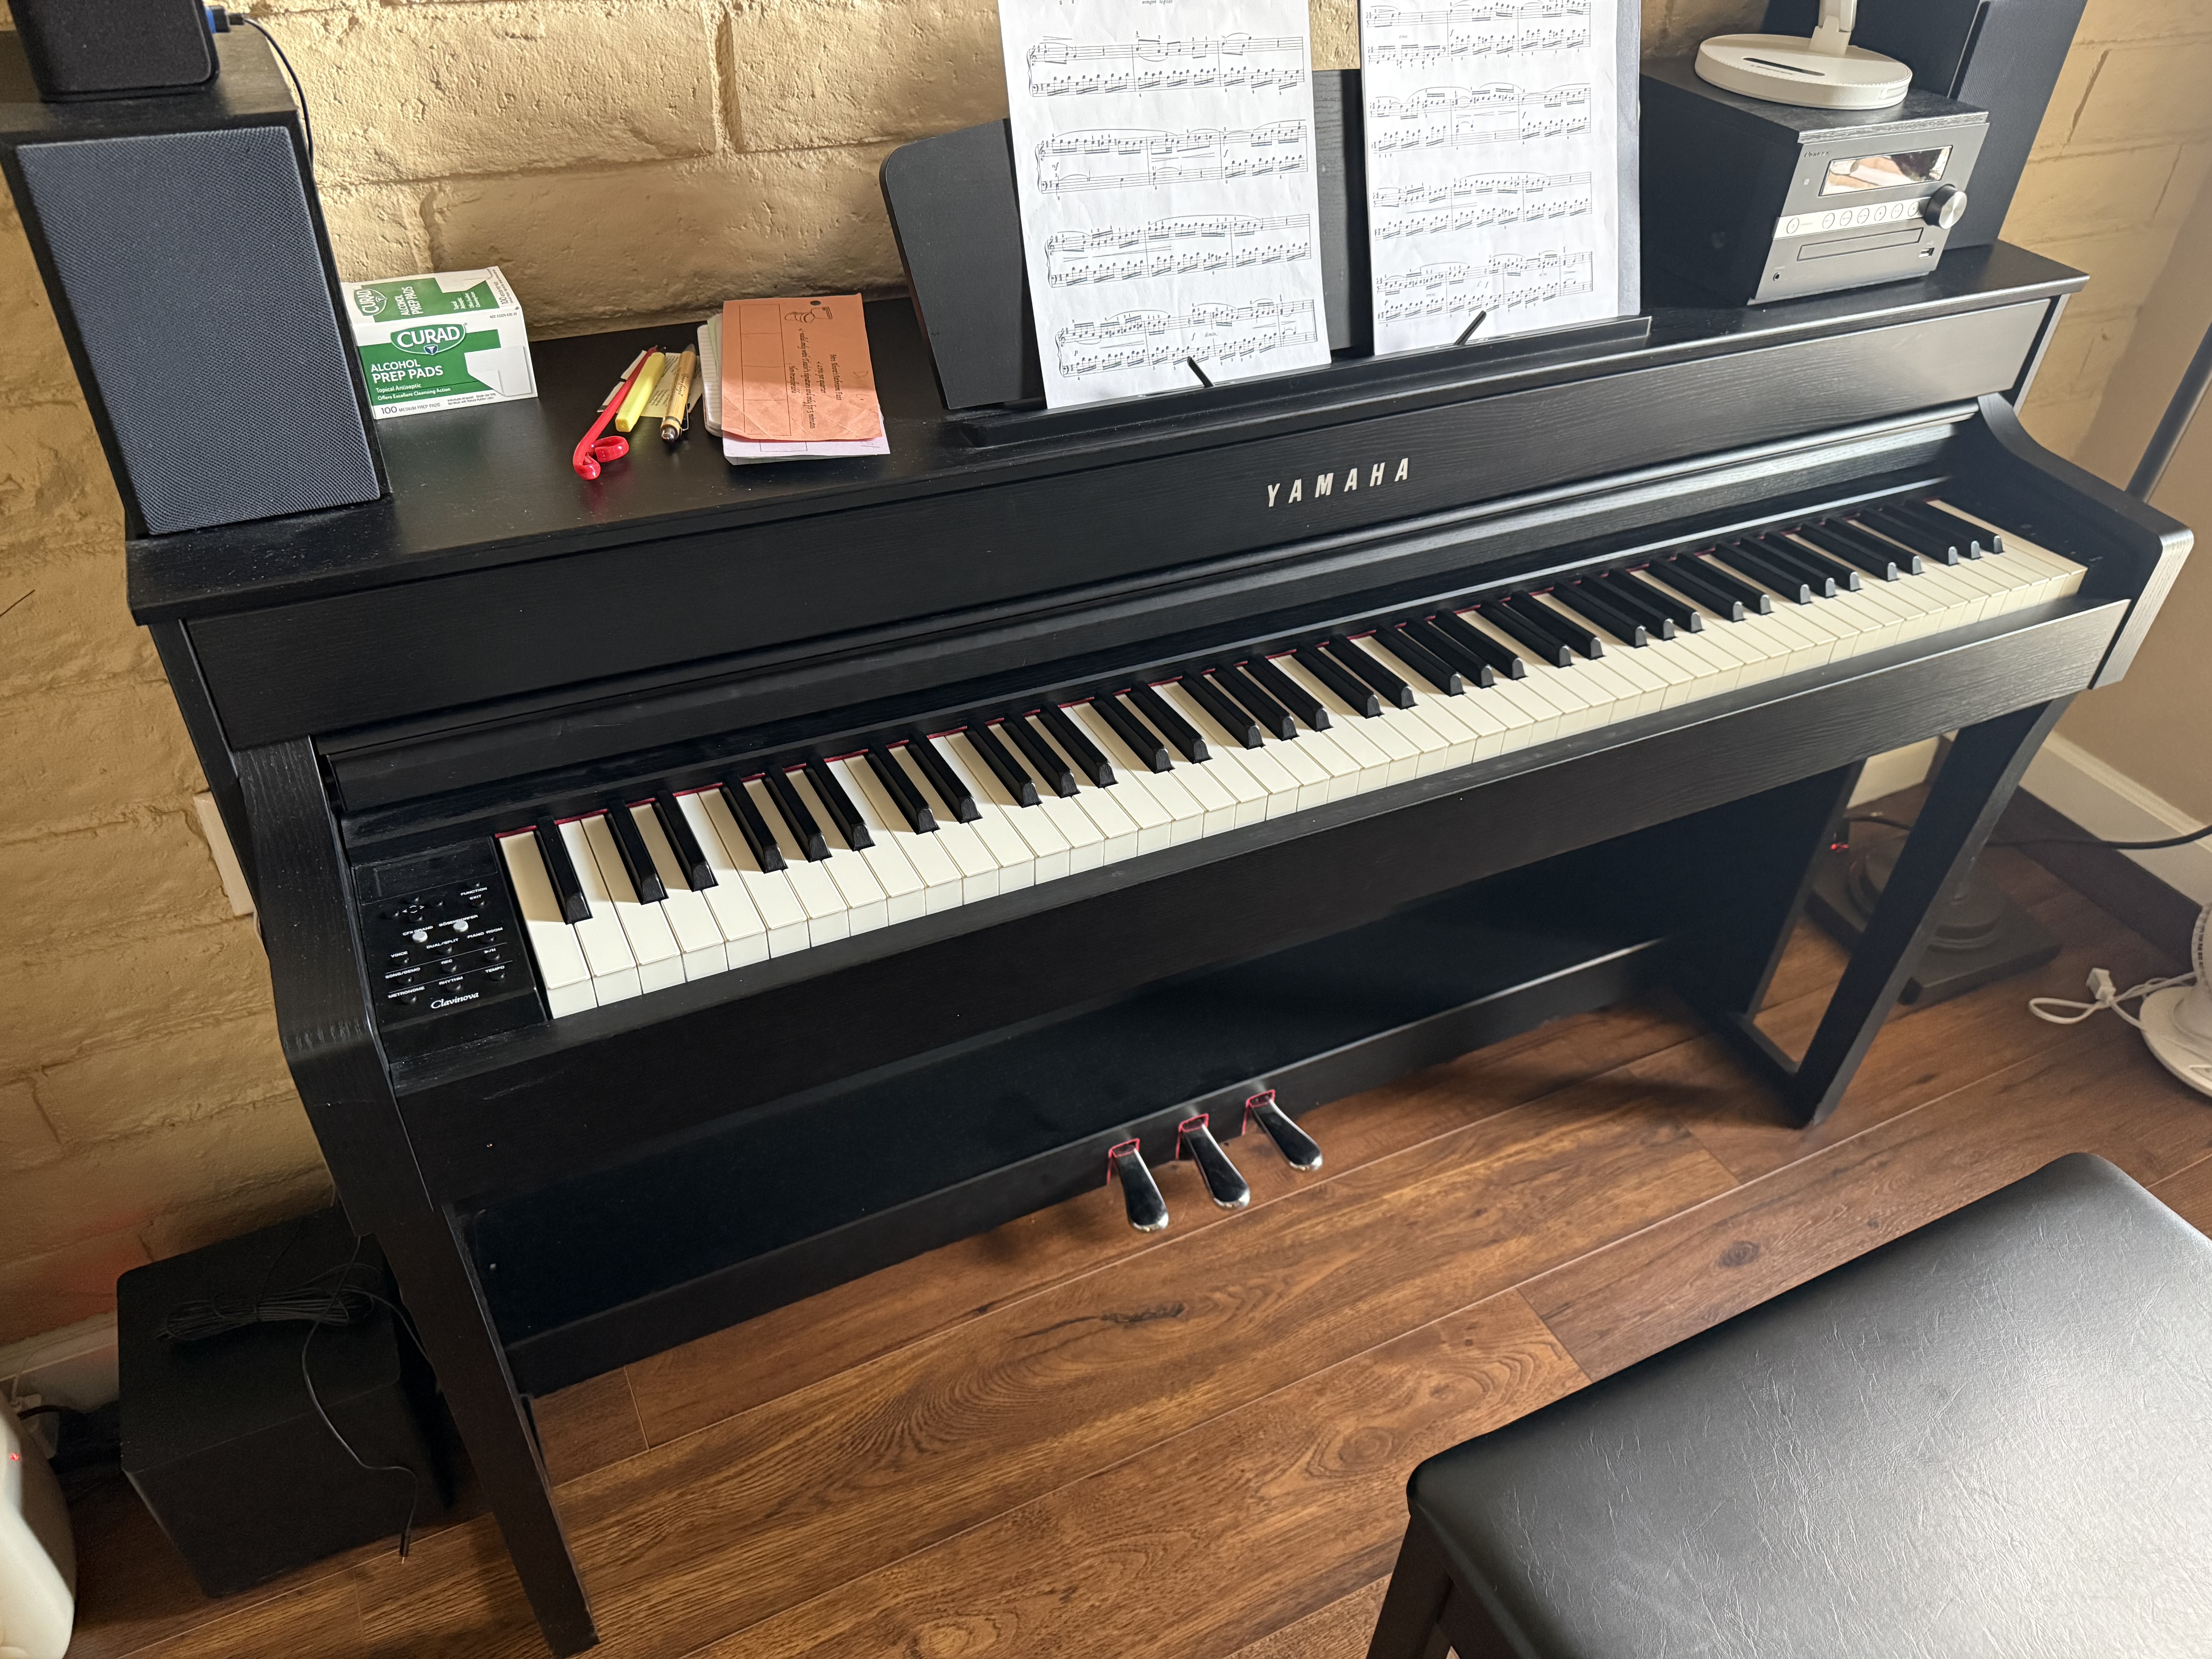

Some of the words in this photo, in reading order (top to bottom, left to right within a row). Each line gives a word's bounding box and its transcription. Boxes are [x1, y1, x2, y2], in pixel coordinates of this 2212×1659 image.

[401, 286, 417, 300] PADS
[356, 290, 380, 313] CURAD
[394, 295, 410, 316] ALCOHOL
[407, 300, 424, 315] PREP
[397, 326, 460, 347] CURAD
[371, 359, 421, 372] ALCOHOL
[371, 370, 406, 384] PREP
[407, 365, 443, 379] PADS
[381, 406, 397, 414] 100
[1267, 457, 1408, 508] YAMAHA
[460, 887, 487, 896] FUNCTION
[439, 914, 478, 927] BÖSENDORFER
[426, 938, 459, 949] DUAL/SPLIT
[385, 967, 421, 979] SONG/DEMO
[439, 976, 463, 986] RHYTHM
[388, 986, 425, 998] METRONOME
[431, 992, 479, 1009] Clavinova
